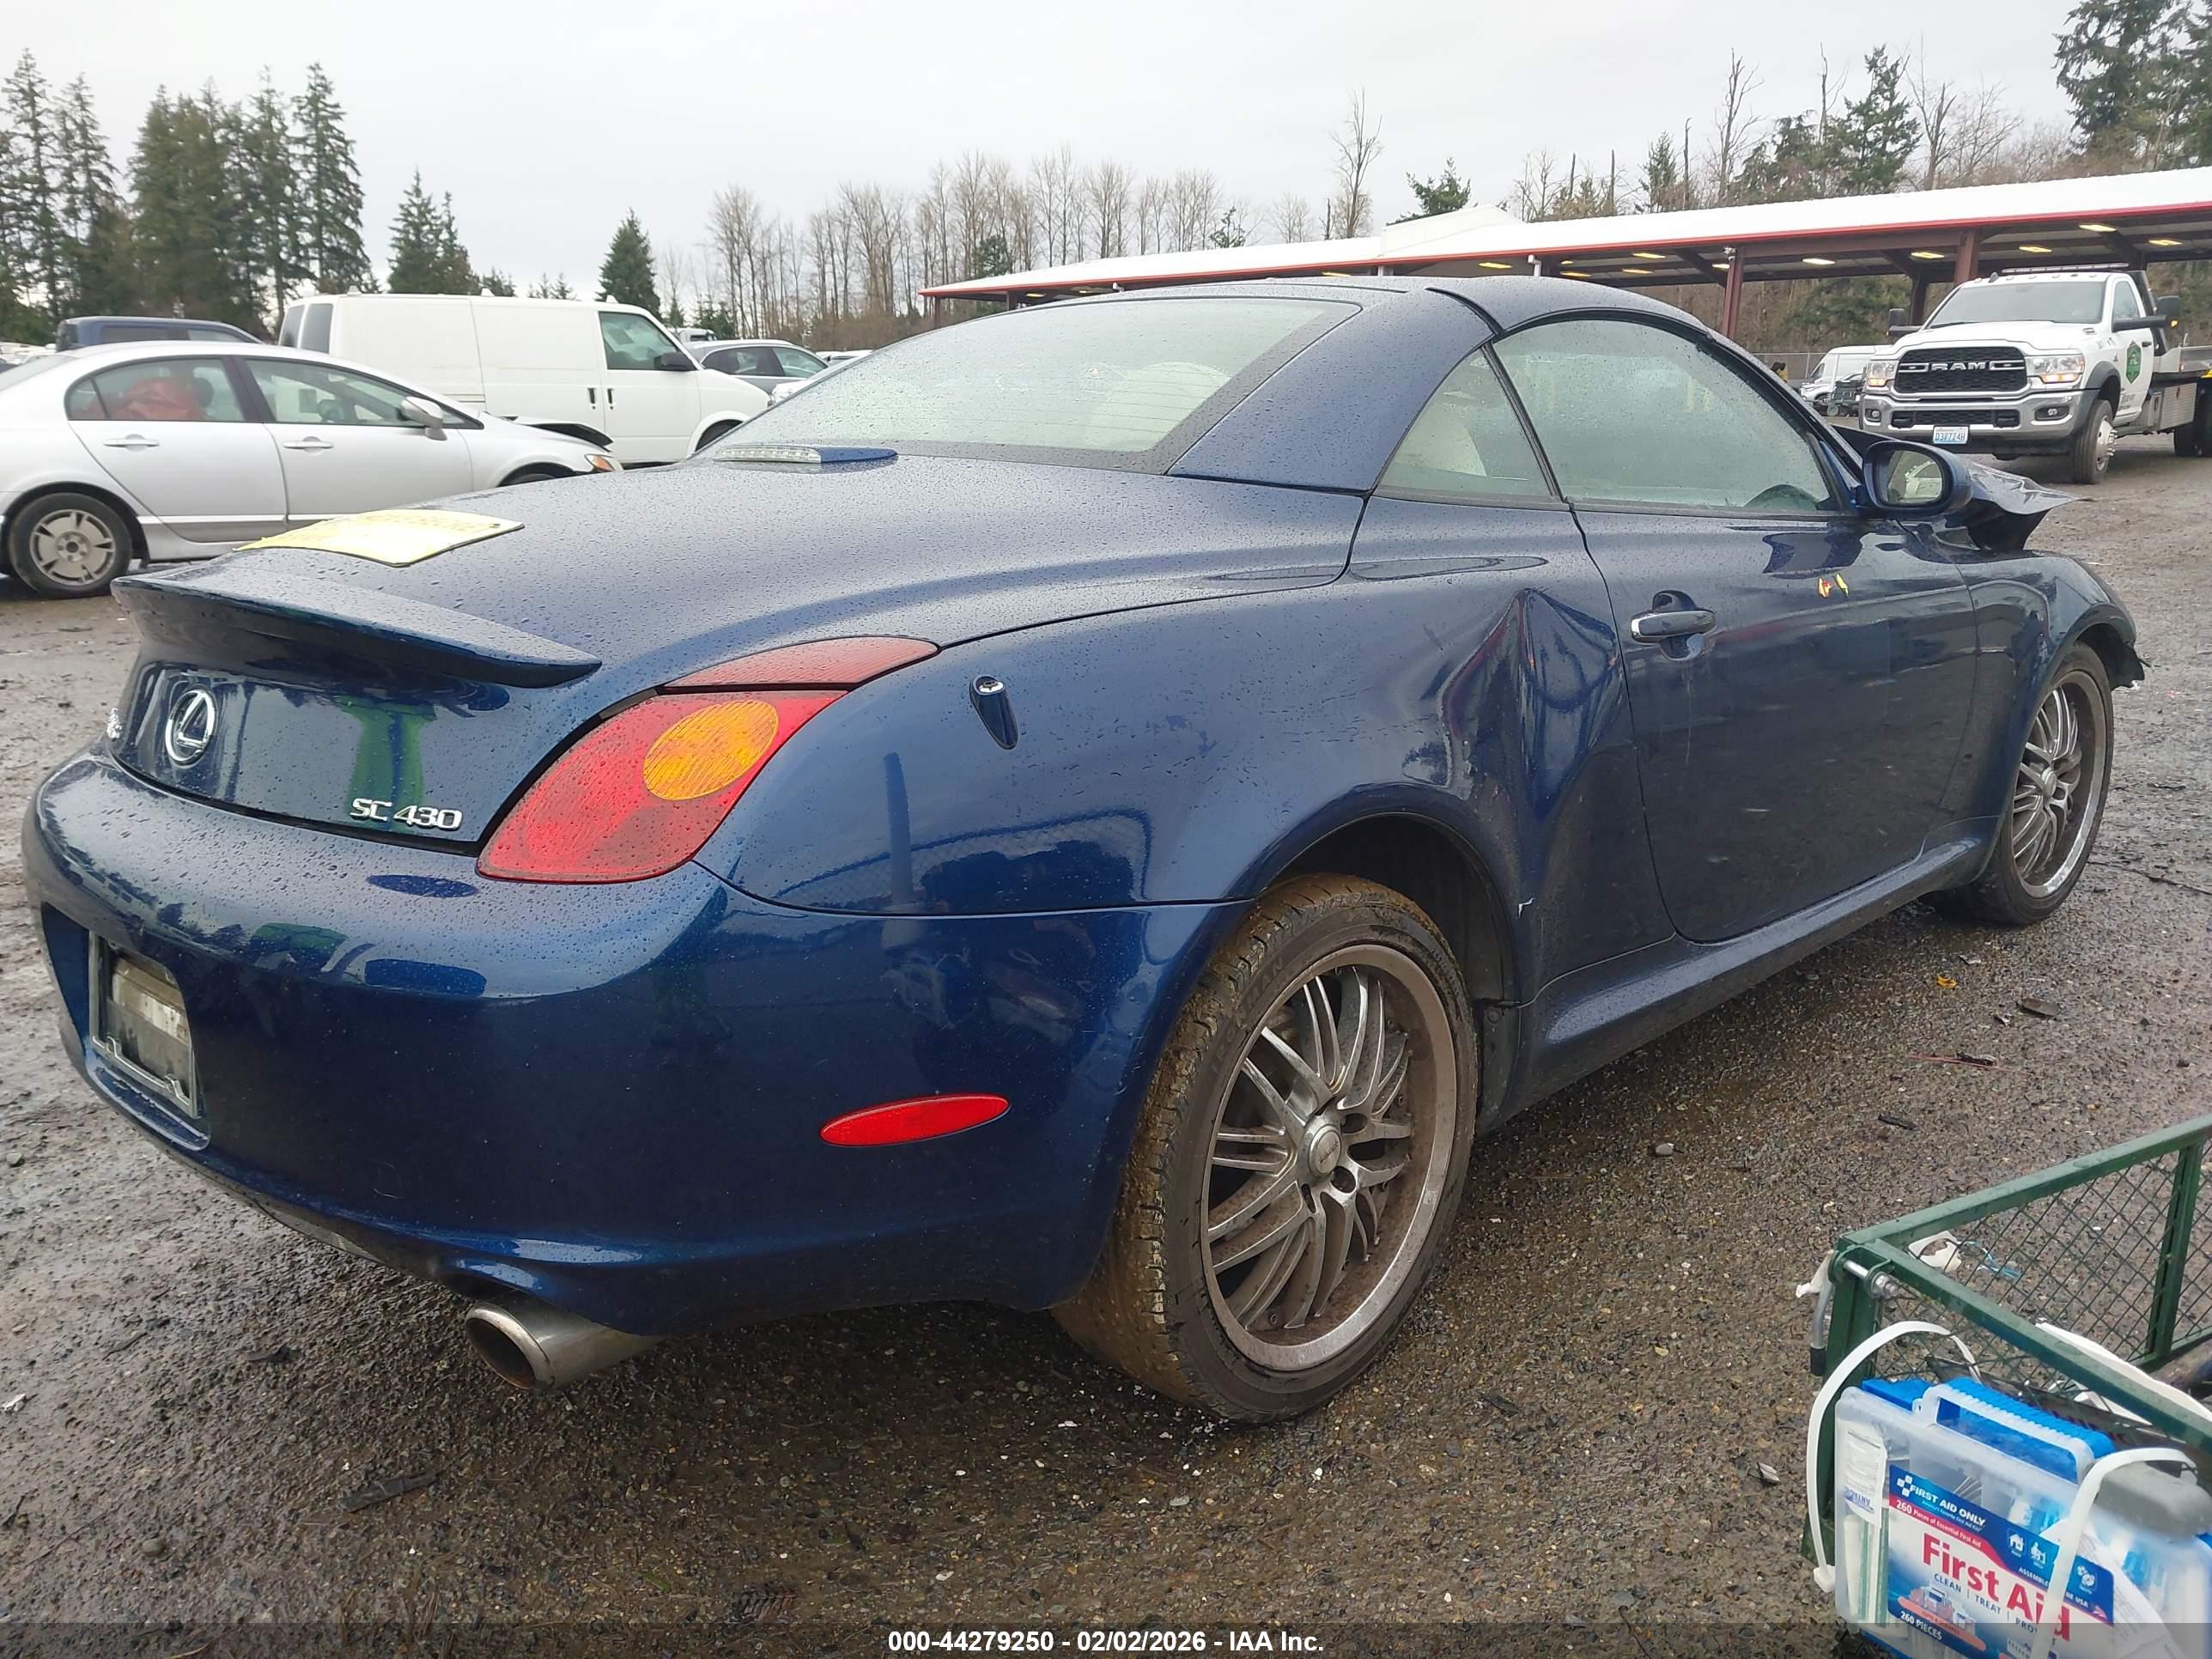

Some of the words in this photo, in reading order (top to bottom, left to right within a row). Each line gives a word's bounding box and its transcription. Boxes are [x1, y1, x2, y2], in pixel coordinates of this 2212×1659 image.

[1931, 362, 1986, 371] RAM
[349, 797, 392, 822] SC
[393, 804, 463, 831] 430
[1896, 1499, 1912, 1514] 260
[1910, 1485, 1939, 1503] FIRST
[1940, 1500, 1957, 1513] AID
[1959, 1509, 1985, 1526] ONLY
[1923, 1533, 1999, 1602] First
[2007, 1583, 2069, 1642] Aid
[1934, 1573, 1961, 1593] CLEAN
[1975, 1595, 2002, 1614] TREAT
[2019, 1567, 2050, 1587] ASSEMBLE
[2075, 1595, 2089, 1607] USA
[1900, 1611, 1915, 1625] 260
[1916, 1620, 1942, 1641] PIECES
